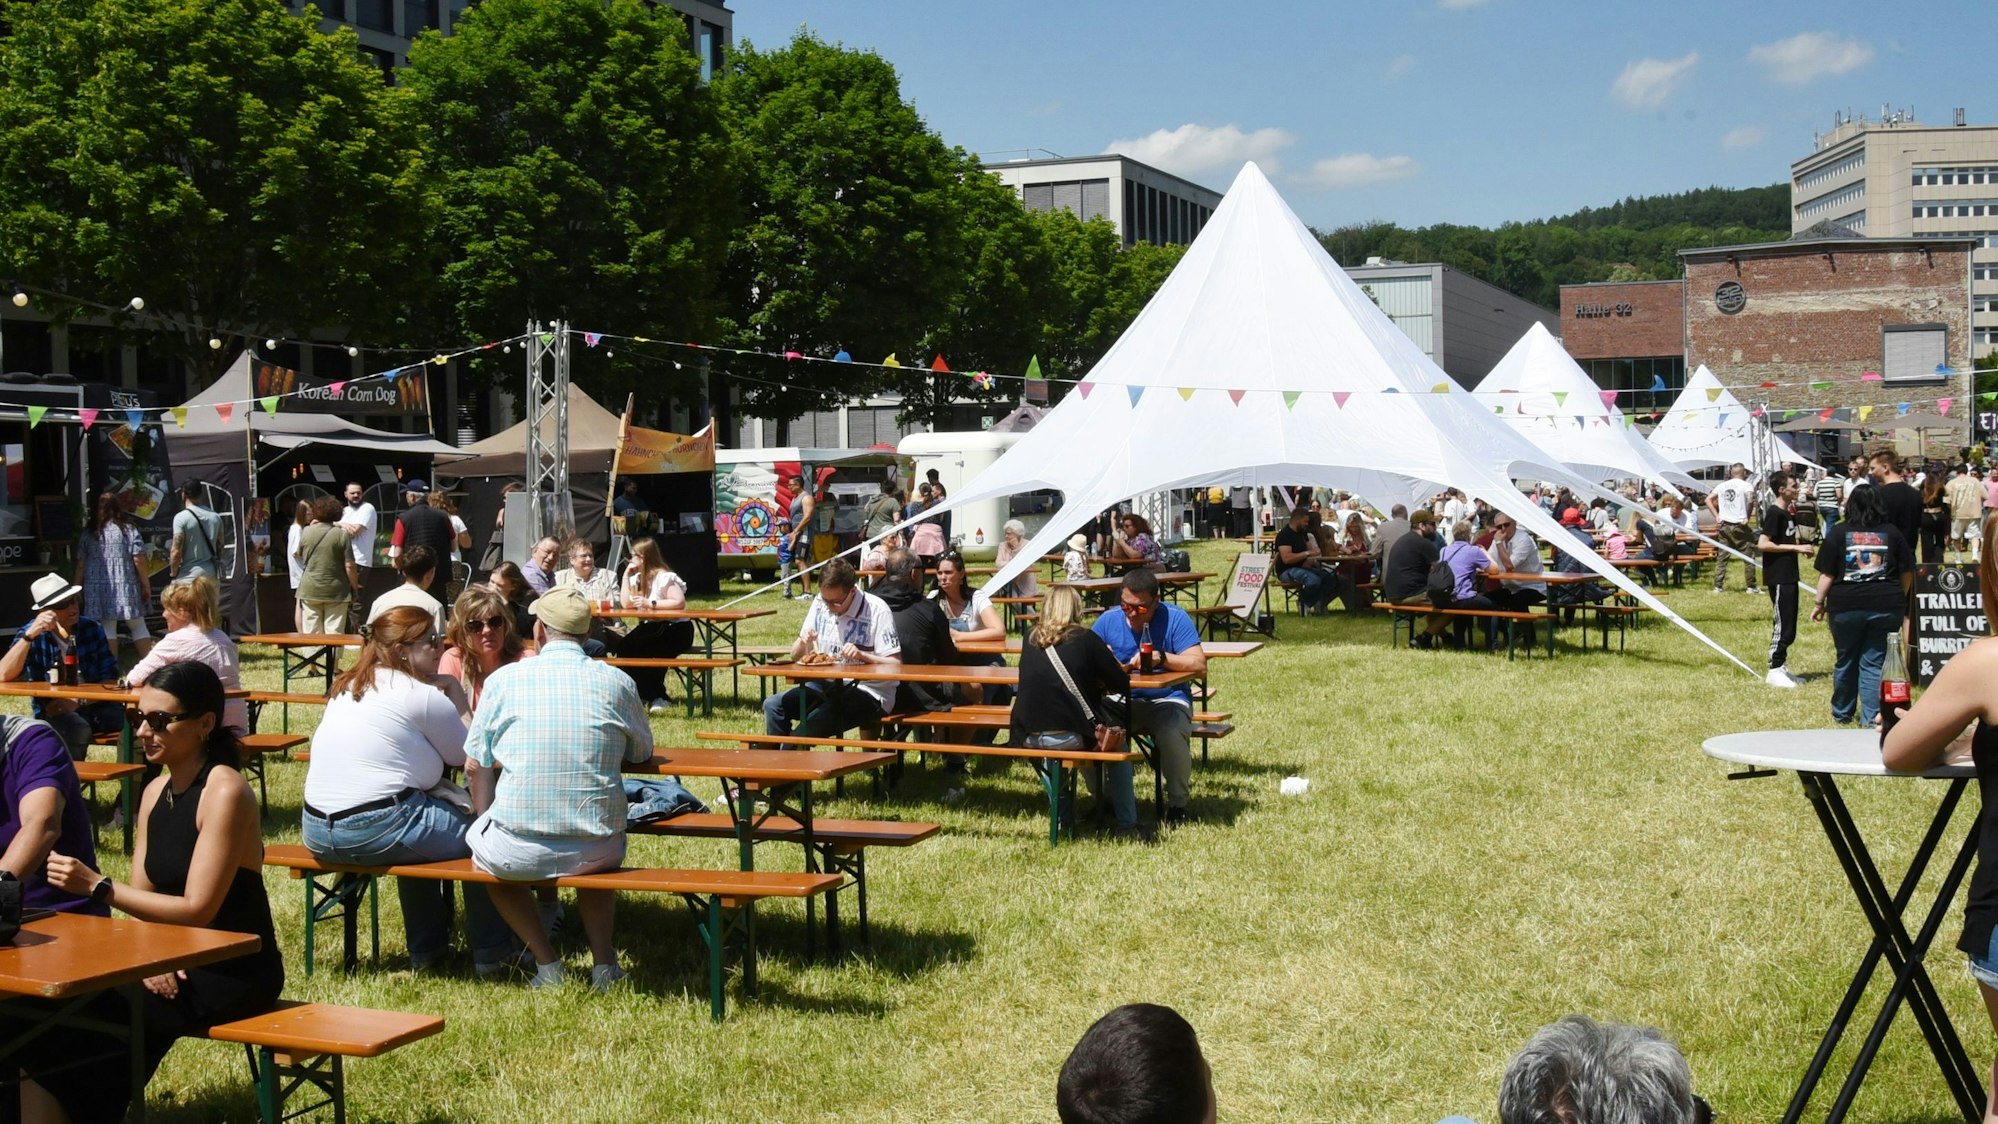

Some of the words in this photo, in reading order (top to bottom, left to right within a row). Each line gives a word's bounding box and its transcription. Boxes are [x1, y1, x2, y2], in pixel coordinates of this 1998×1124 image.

[1575, 304, 1611, 315] Halle
[1616, 302, 1632, 314] 32
[298, 382, 344, 400] Korean
[347, 386, 373, 401] Corn
[375, 386, 396, 405] Dog
[1979, 412, 1998, 430] Ei
[1238, 573, 1264, 583] FOOD
[1920, 616, 1961, 631] FULL
[1966, 615, 1988, 631] OF
[1919, 638, 1973, 653] BURRIT
[1921, 660, 1934, 676] &
